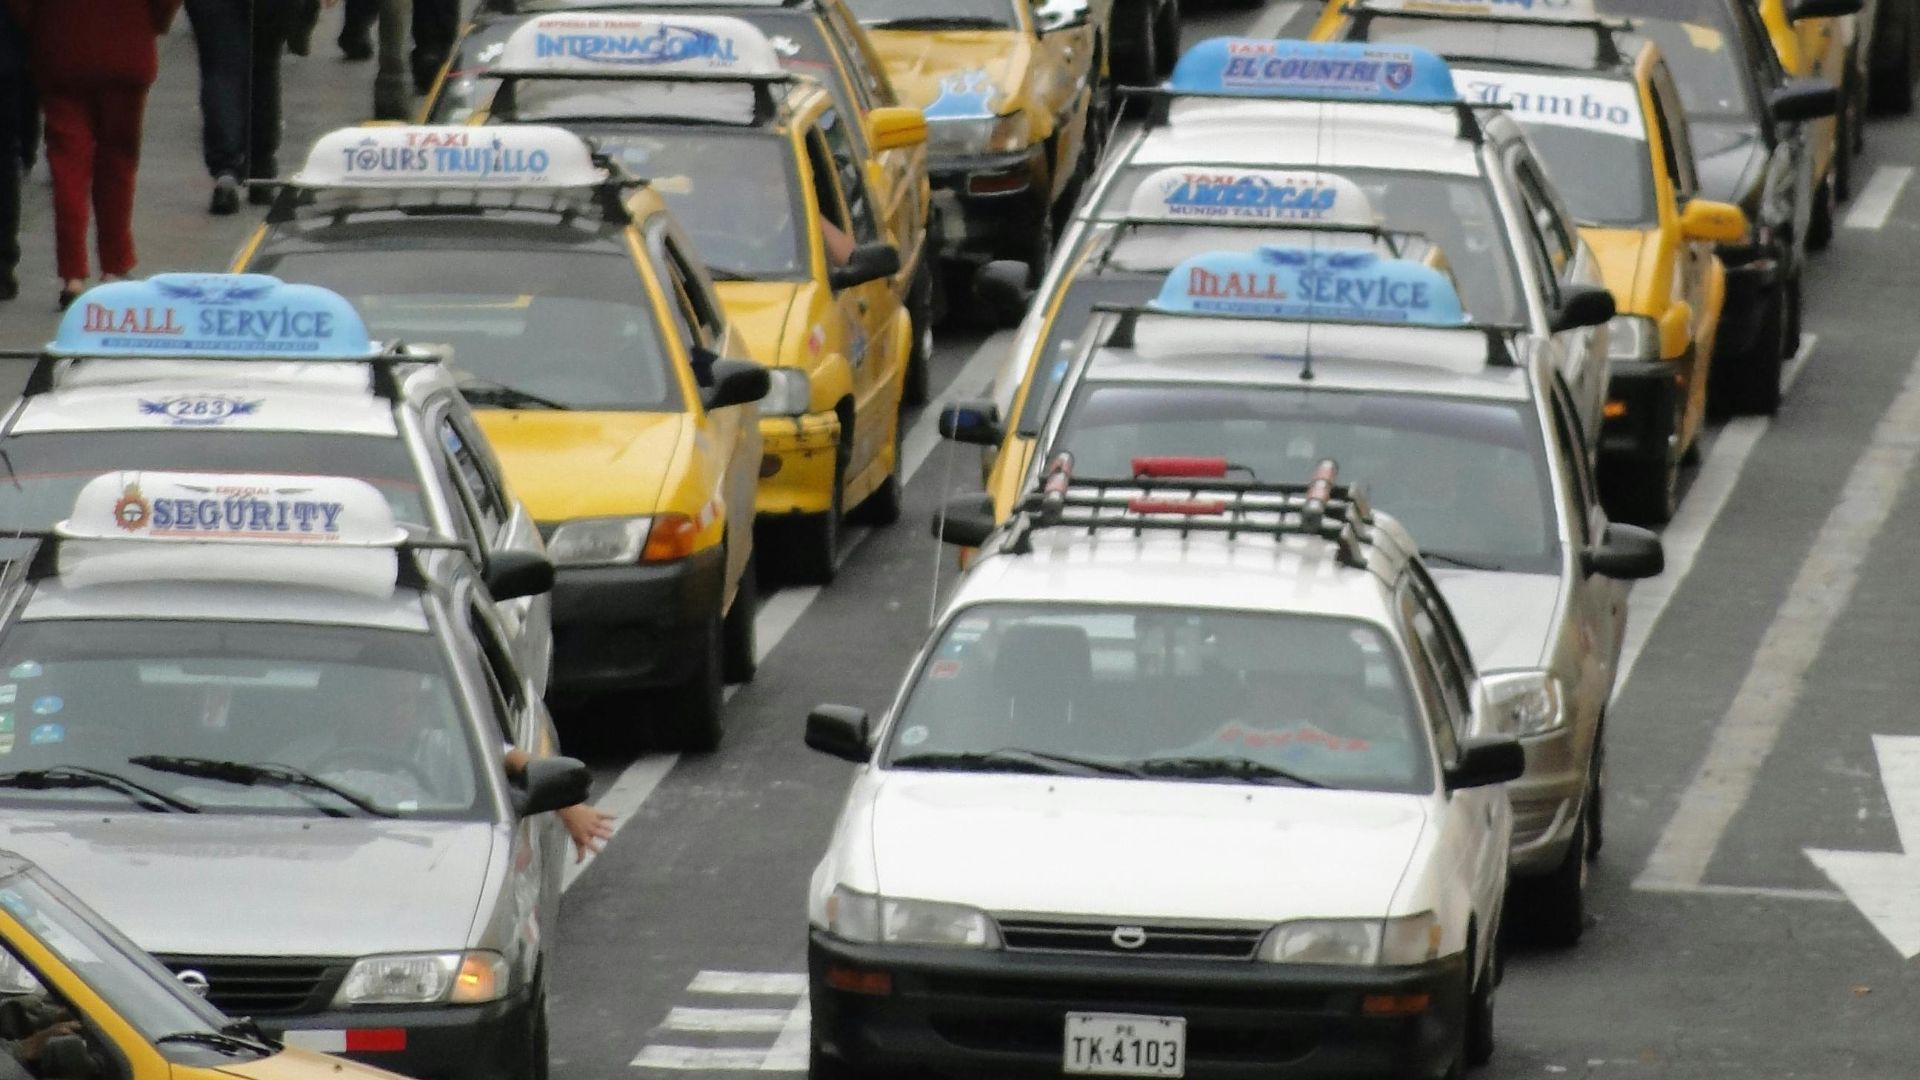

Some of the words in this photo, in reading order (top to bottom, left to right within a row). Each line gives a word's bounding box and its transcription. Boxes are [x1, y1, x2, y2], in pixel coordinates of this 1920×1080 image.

[535, 27, 737, 61] INTERNACIONAL
[1223, 57, 1257, 77] EL
[406, 132, 469, 146] TAXI
[343, 147, 428, 172] TOURS
[434, 142, 549, 177] TRUJILLO
[1184, 174, 1235, 184] TAXI
[1169, 205, 1229, 216] MUNDO
[1297, 272, 1430, 309] SERVICE
[200, 306, 333, 338] SERVICE
[178, 400, 223, 415] 283
[1073, 1036, 1177, 1068] TK-4103
